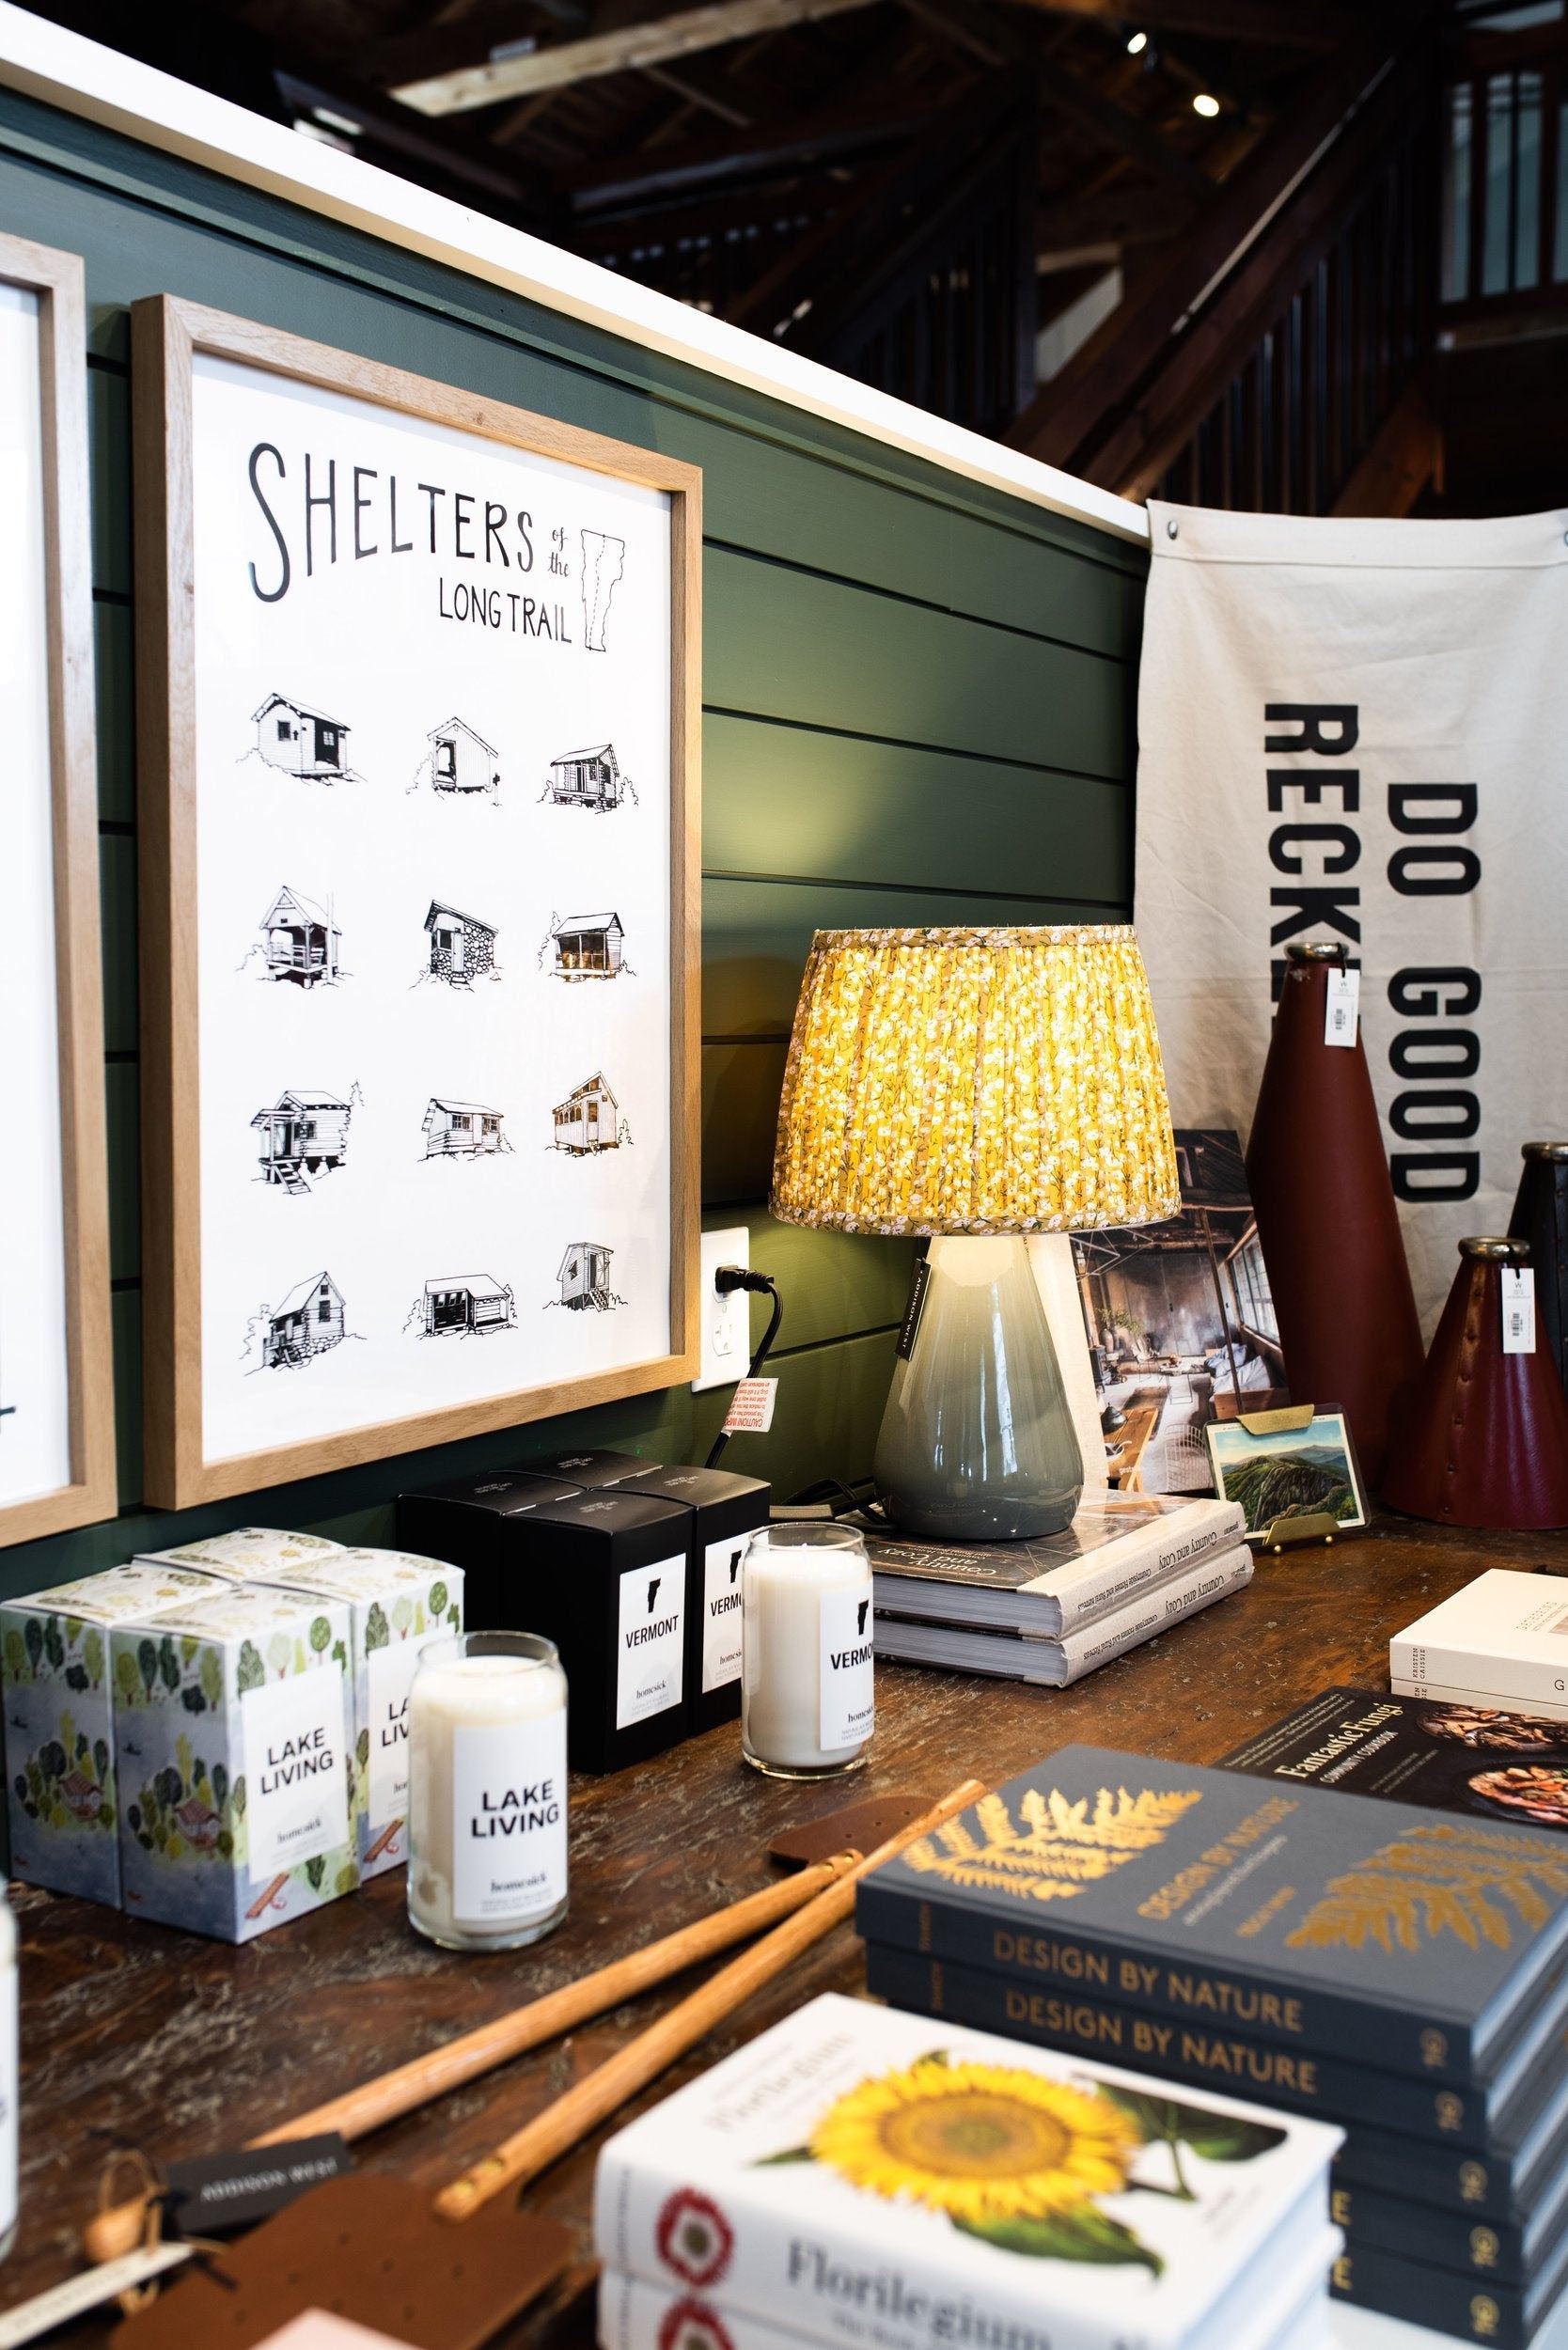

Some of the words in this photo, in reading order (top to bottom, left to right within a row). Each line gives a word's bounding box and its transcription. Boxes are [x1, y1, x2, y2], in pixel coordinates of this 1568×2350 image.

[248, 443, 533, 603] SHELTERS
[552, 527, 569, 553] of
[548, 553, 570, 577] the
[440, 577, 500, 629] LONG
[508, 594, 572, 644] TRAIL
[1387, 783, 1482, 896] DO
[1264, 703, 1361, 1034] RECK
[1388, 966, 1482, 1202] GOOD
[909, 1277, 921, 1321] ADDISON
[902, 1324, 911, 1348] WEST
[877, 1547, 929, 1560] Cozy
[933, 1556, 977, 1564] and
[1177, 1544, 1189, 1565] and
[1191, 1531, 1217, 1556] Country
[909, 1559, 996, 1575] Country
[1158, 1551, 1175, 1571] Cozy
[1184, 1590, 1197, 1608] and
[1198, 1574, 1225, 1597] Country
[1165, 1598, 1182, 1616] Cozy
[625, 1614, 679, 1649] VERMONT
[636, 1679, 666, 1700] homesick
[268, 1728, 325, 1767] LAKE
[1274, 1733, 1363, 1778] Fantastic
[1340, 1702, 1403, 1733] Fungi
[260, 1751, 334, 1795] LIVING
[1320, 1754, 1366, 1784] COMMUNITY
[481, 1779, 554, 1812] LAKE
[471, 1803, 559, 1839] LIVING
[993, 1930, 1109, 1985] DESIGN
[1120, 1957, 1156, 1997] BY
[1168, 1967, 1302, 2032] NATURE
[1006, 1990, 1122, 2045] DESIGN
[1134, 2017, 1170, 2057] BY
[1182, 2029, 1316, 2094] NATURE
[786, 2236, 1053, 2350] Florilegium
